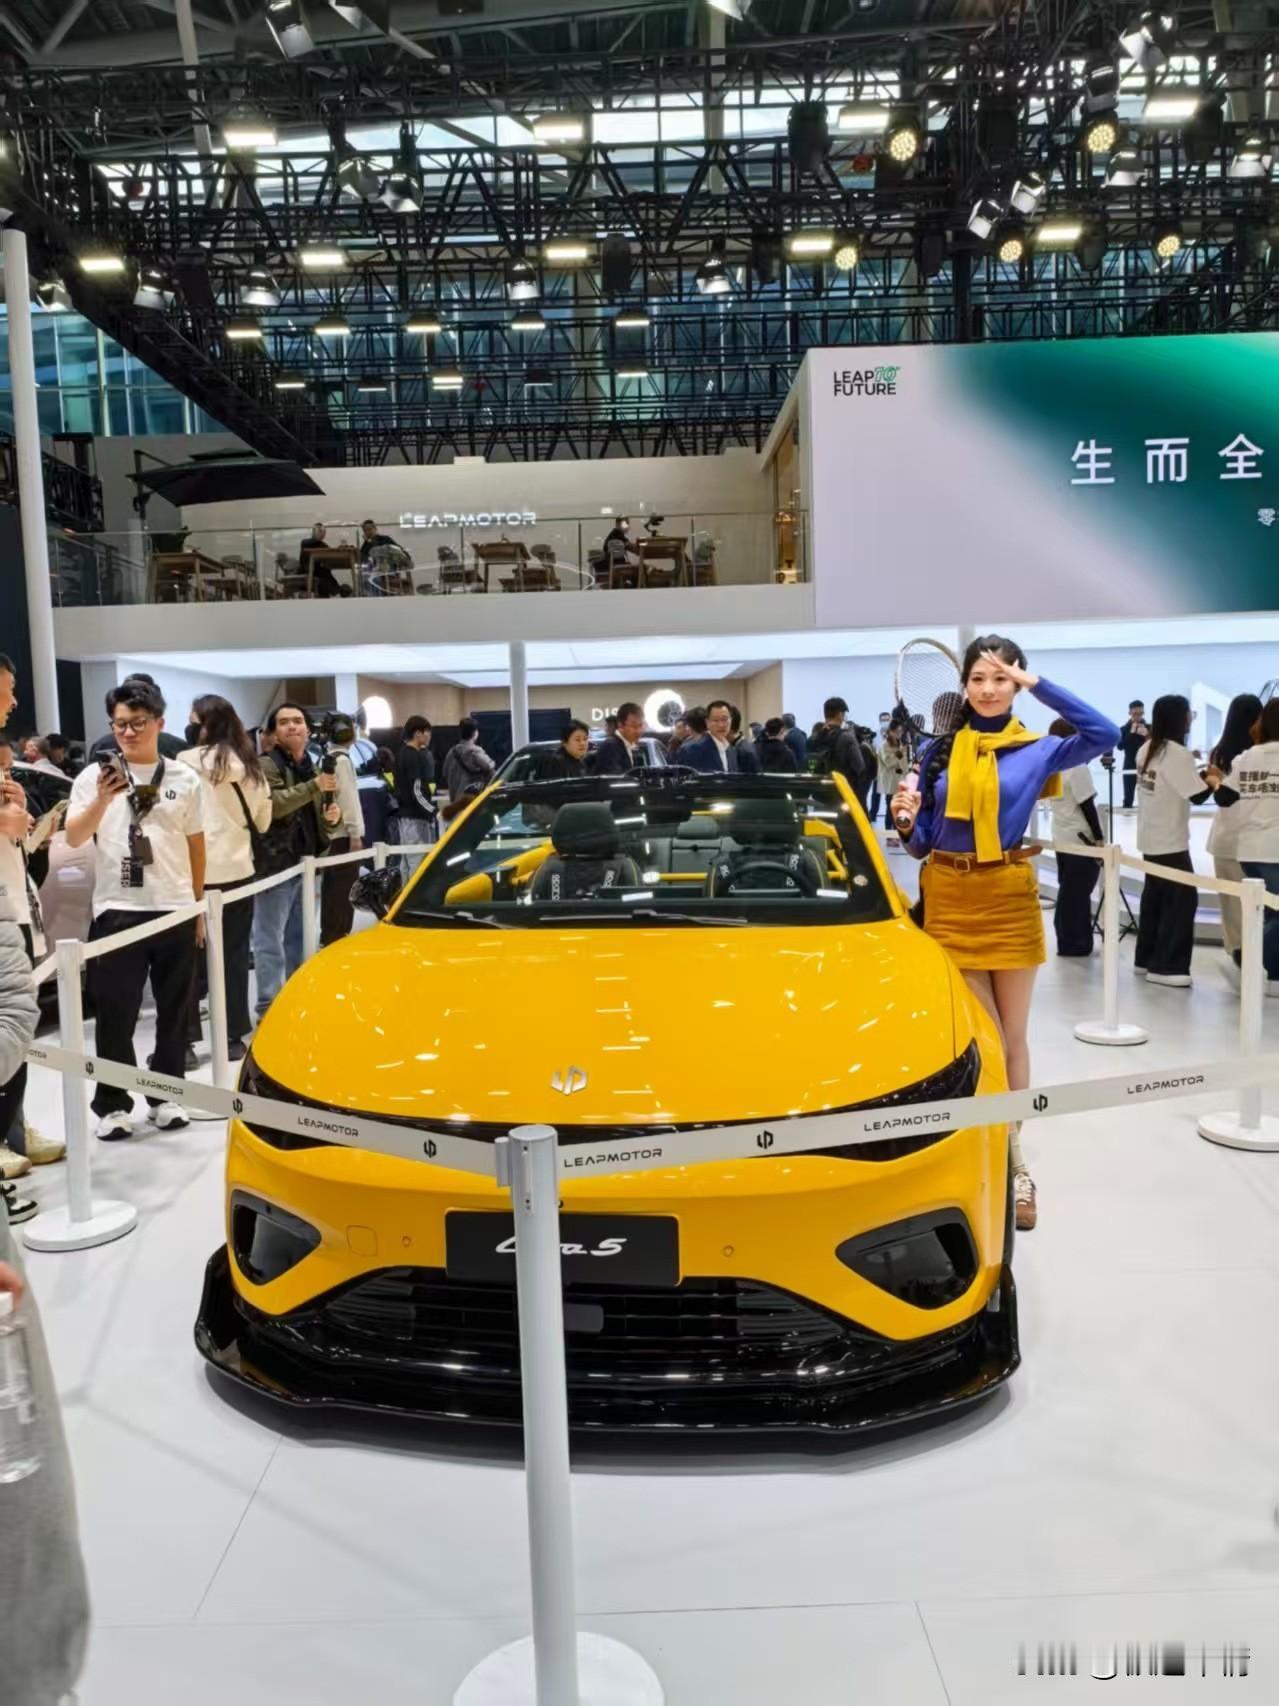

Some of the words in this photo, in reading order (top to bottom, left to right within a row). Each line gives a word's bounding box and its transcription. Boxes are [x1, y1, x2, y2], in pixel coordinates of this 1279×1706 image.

[834, 370, 875, 384] LEAP
[833, 383, 897, 397] FUTURE
[399, 511, 537, 529] LEAPMOTOR
[136, 1077, 184, 1097] LEAPMOTOR
[1127, 1075, 1205, 1095] LEAPMOTOR
[297, 1116, 359, 1138] LEAPMOTOR
[863, 1112, 951, 1132] LEAPMOTOR
[563, 1148, 663, 1169] LEAPMOTOR
